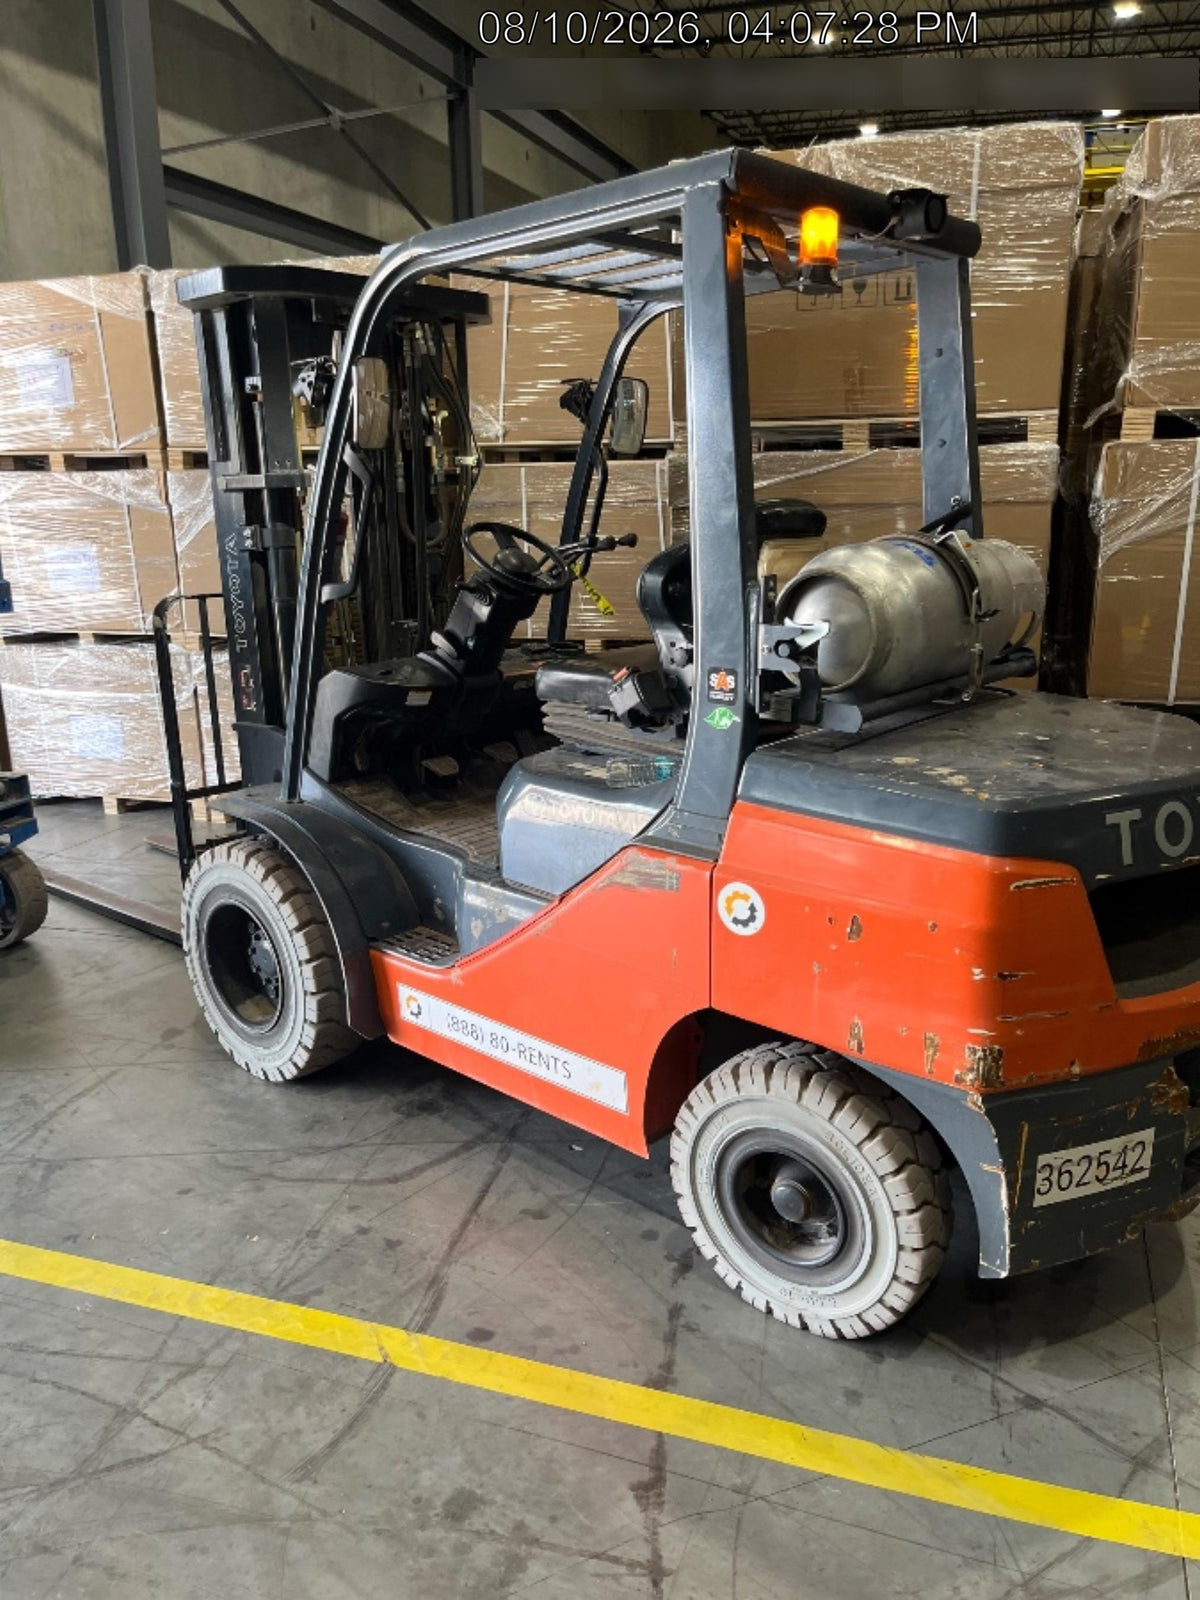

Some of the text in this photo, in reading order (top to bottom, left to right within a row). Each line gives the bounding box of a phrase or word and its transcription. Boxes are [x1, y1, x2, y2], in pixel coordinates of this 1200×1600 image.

[224, 533, 249, 653] TOYOTA
[1105, 796, 1200, 866] TO
[447, 1013, 573, 1080] (888) 80-RENTS
[1036, 1140, 1150, 1196] 362542
